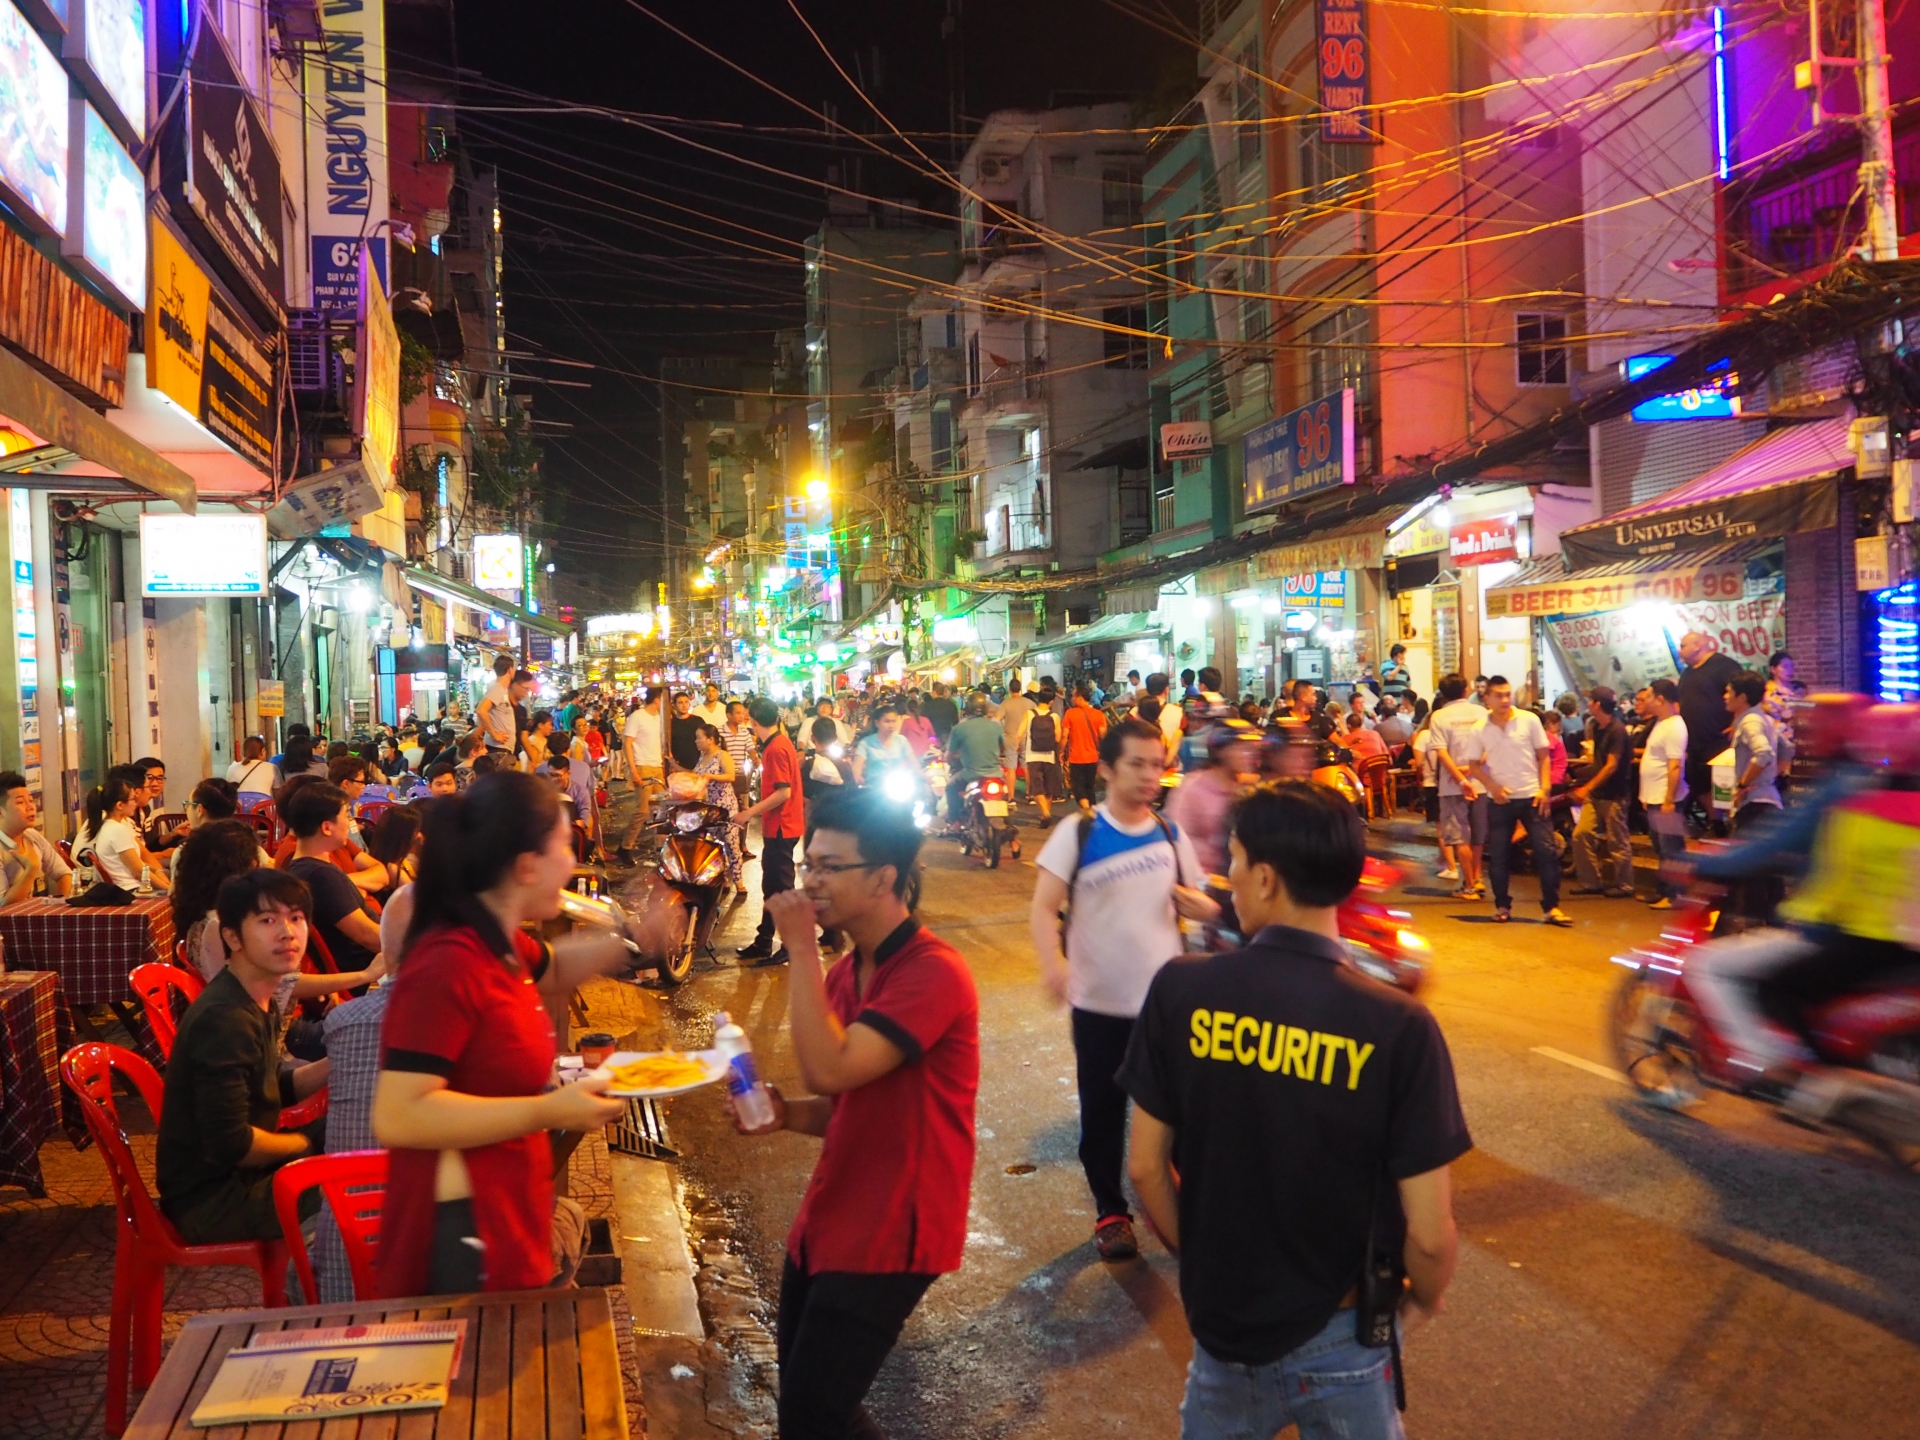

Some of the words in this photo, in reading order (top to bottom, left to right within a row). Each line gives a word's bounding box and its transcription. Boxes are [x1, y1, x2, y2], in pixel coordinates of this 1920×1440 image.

[1324, 11, 1360, 35] RENT
[1322, 37, 1364, 80] 96
[324, 32, 368, 215] NGUYEN
[1296, 401, 1332, 469] 96
[1319, 596, 1344, 607] STORE
[1320, 582, 1345, 595] RENT
[1511, 588, 1574, 613] BEER
[1702, 571, 1739, 597] 96
[1189, 1008, 1376, 1091] SECURITY
